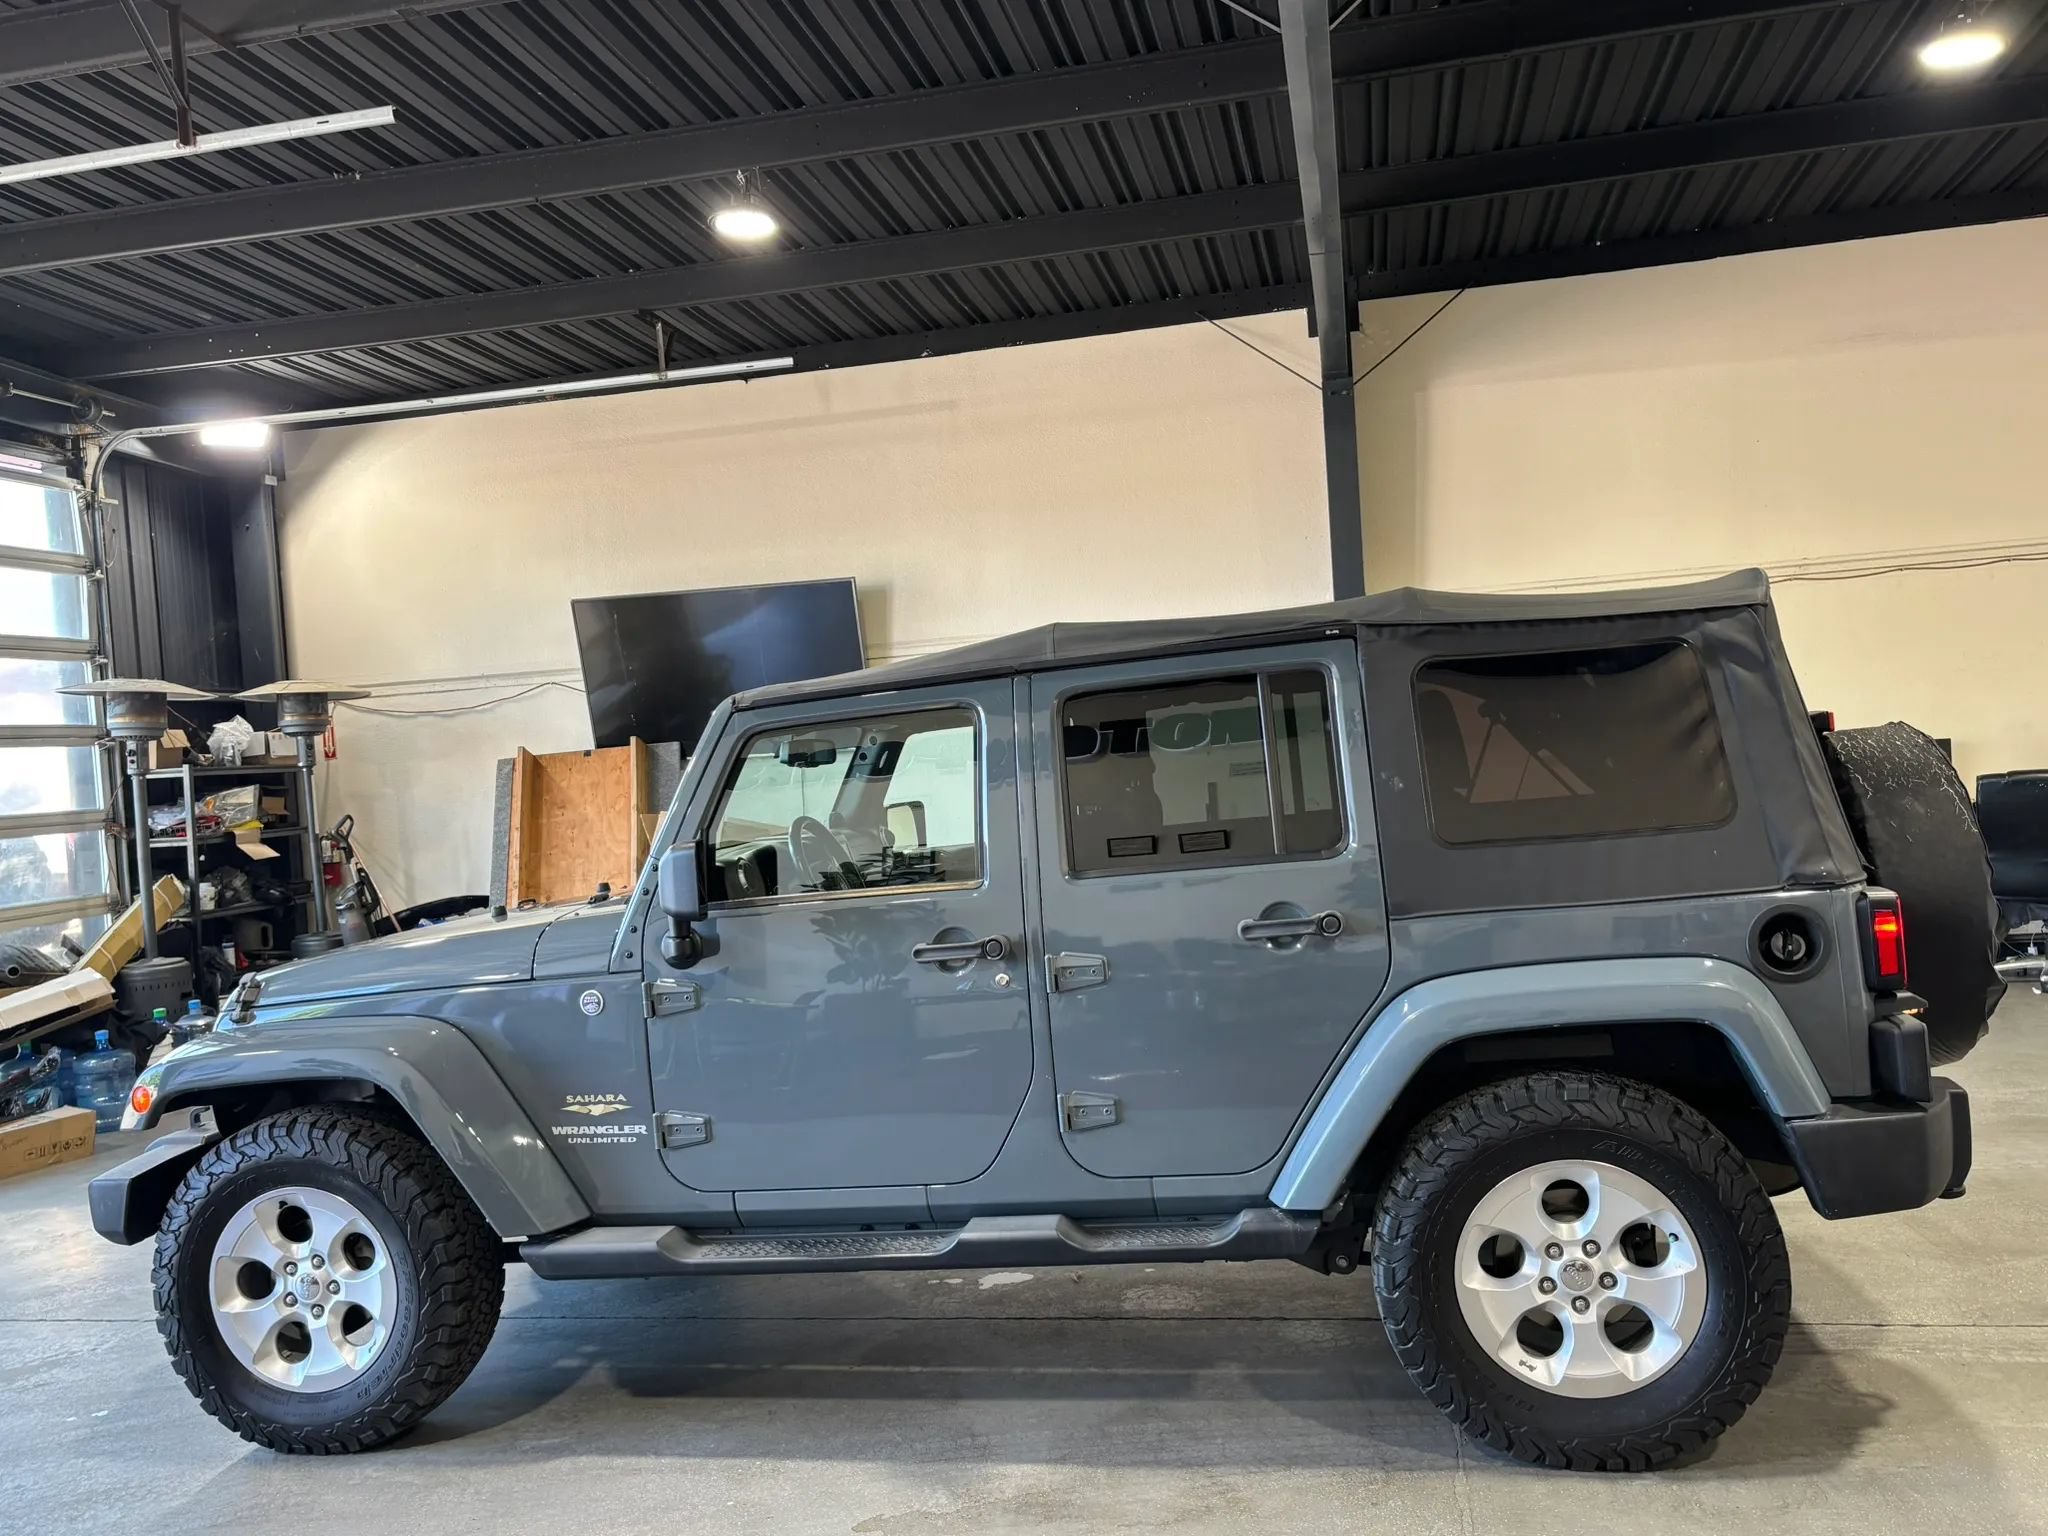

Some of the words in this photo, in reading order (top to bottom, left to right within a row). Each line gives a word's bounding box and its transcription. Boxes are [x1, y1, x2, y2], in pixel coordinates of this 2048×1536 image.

[566, 1093, 627, 1103] SAHARA
[552, 1124, 648, 1135] WRANGLER
[568, 1136, 637, 1144] UNLIMITED
